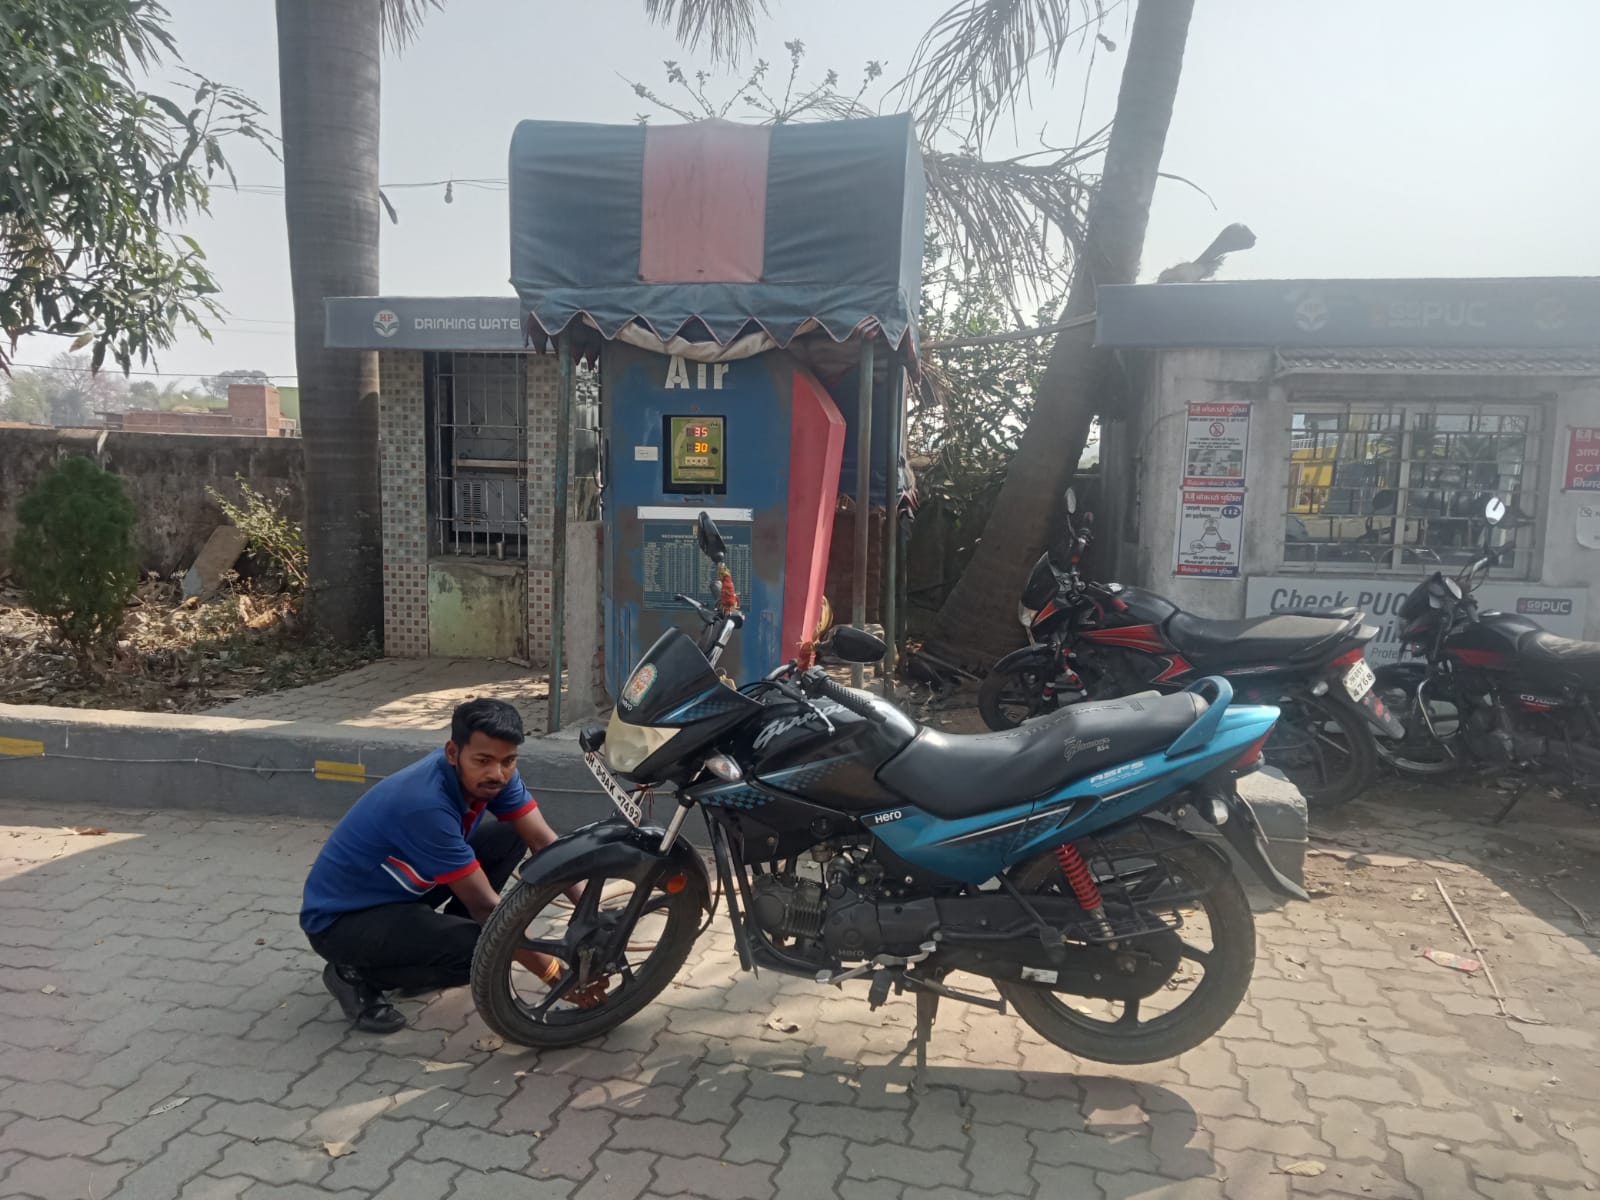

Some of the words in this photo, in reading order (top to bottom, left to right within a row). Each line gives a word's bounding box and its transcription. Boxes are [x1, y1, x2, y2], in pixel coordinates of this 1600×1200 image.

[379, 314, 394, 322] HP
[414, 318, 476, 330] DRINKING
[479, 319, 520, 330] WATE
[664, 357, 729, 390] Air
[694, 427, 709, 438] 35
[694, 442, 709, 453] 30
[1270, 588, 1350, 611] Check
[874, 810, 902, 824] Hero
